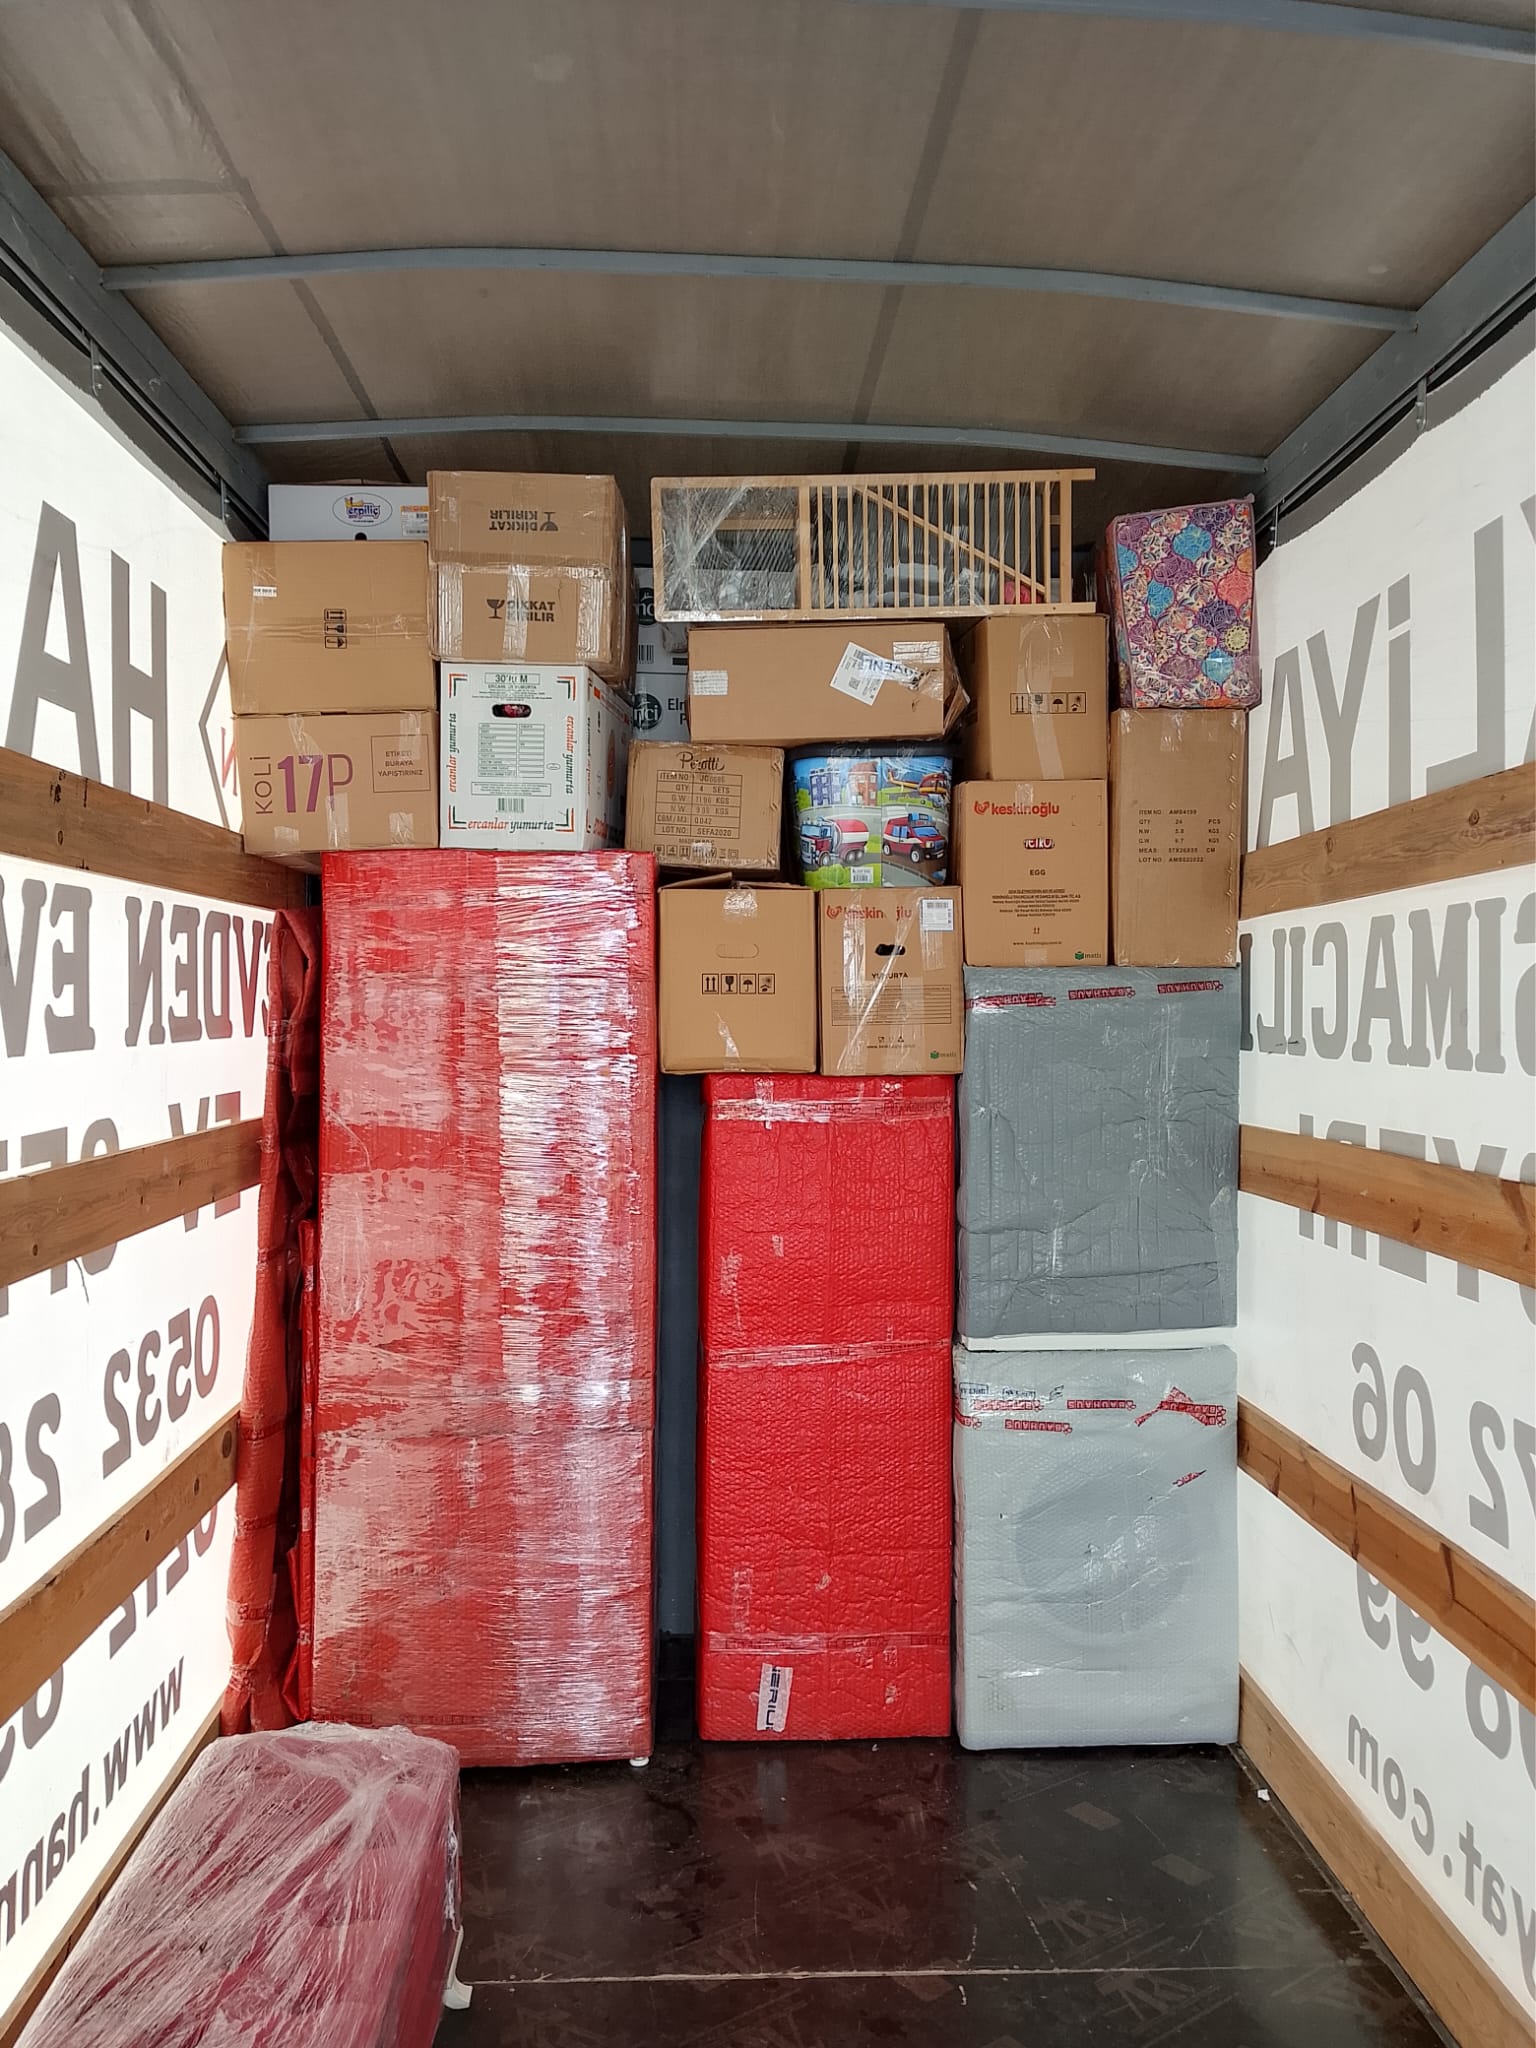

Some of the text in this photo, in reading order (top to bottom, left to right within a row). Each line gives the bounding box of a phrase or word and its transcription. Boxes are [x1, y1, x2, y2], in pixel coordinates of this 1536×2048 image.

[490, 510, 538, 520] KIRILIR
[520, 674, 528, 683] M
[446, 712, 460, 793] ercanlar yumurta
[562, 715, 577, 795] ercanlar yumurta
[467, 817, 554, 833] ercanlar yumurta
[1067, 1400, 1127, 1410] BAUHAUS
[1005, 1419, 1064, 1432] BAUHAUS
[765, 1666, 781, 1730] ERIU
